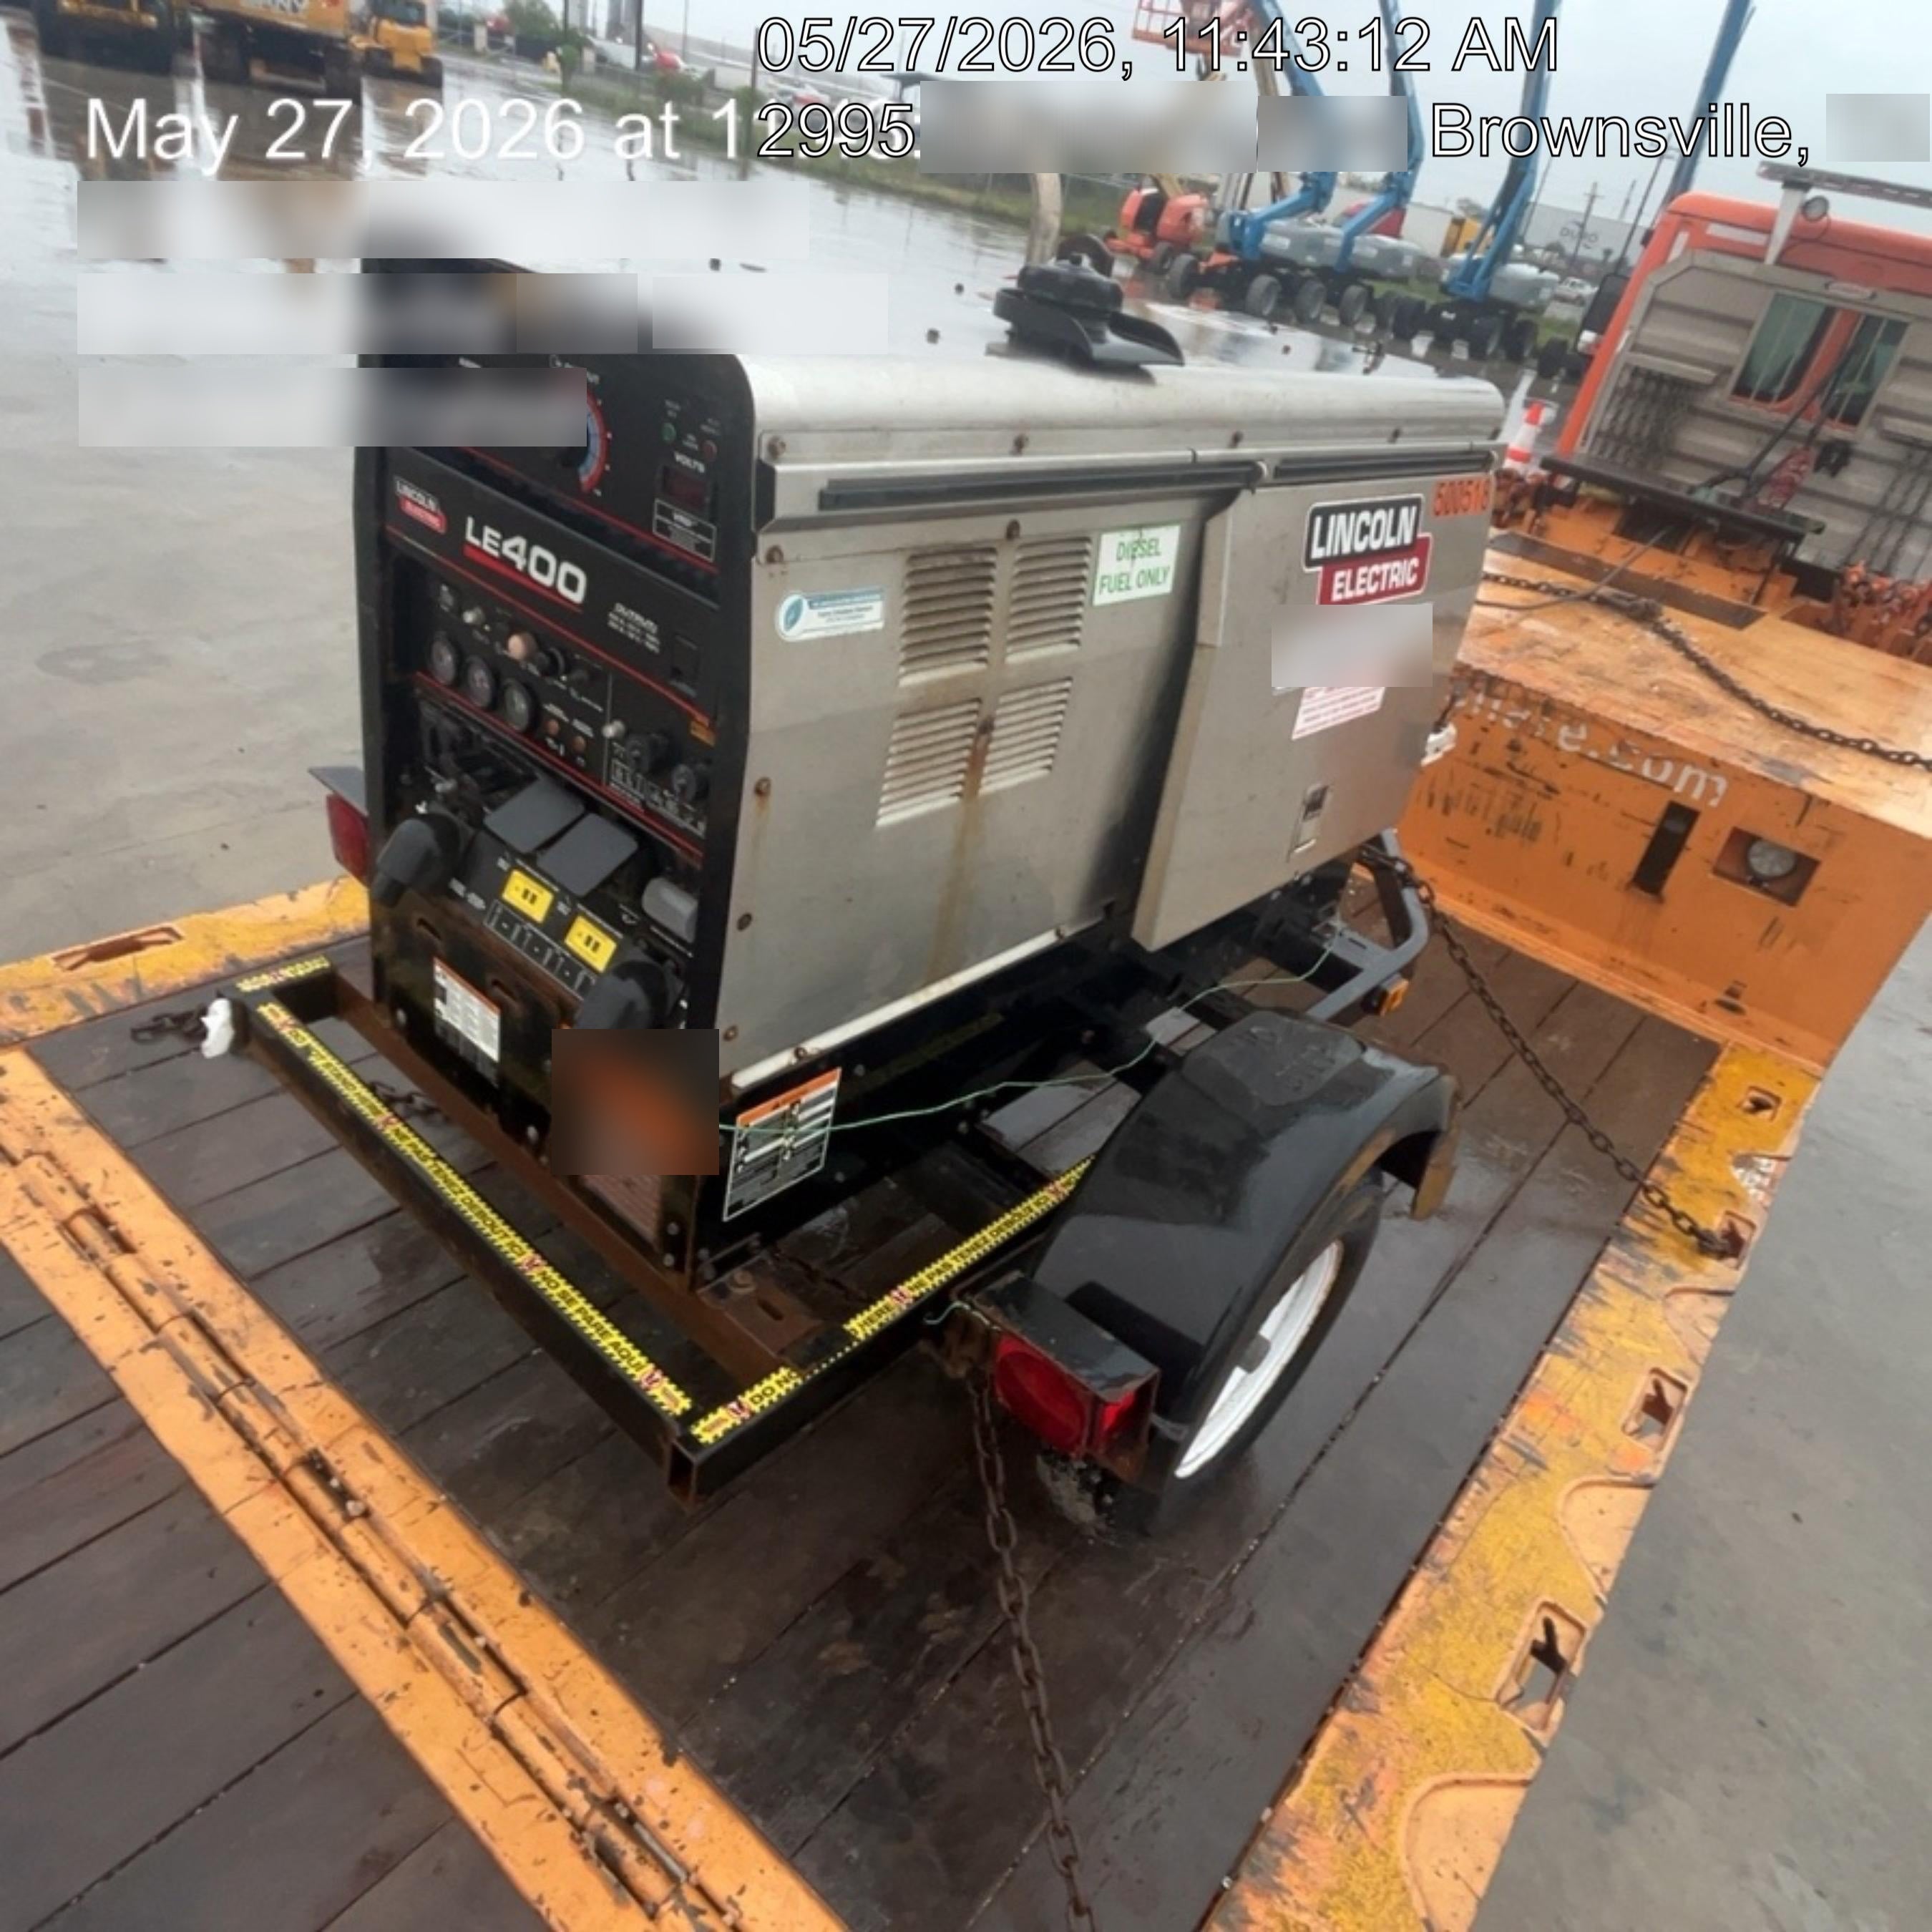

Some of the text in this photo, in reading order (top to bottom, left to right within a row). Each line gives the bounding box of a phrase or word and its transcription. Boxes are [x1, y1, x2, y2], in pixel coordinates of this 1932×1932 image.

[1116, 537, 1162, 561] DIESEL
[1311, 505, 1418, 560] LINCOLN
[465, 515, 587, 605] LE400
[1098, 565, 1171, 595] FUEL ONLY
[1331, 557, 1420, 602] ELECTRIC
[573, 1304, 613, 1342] PARE
[747, 1382, 776, 1406] DO
